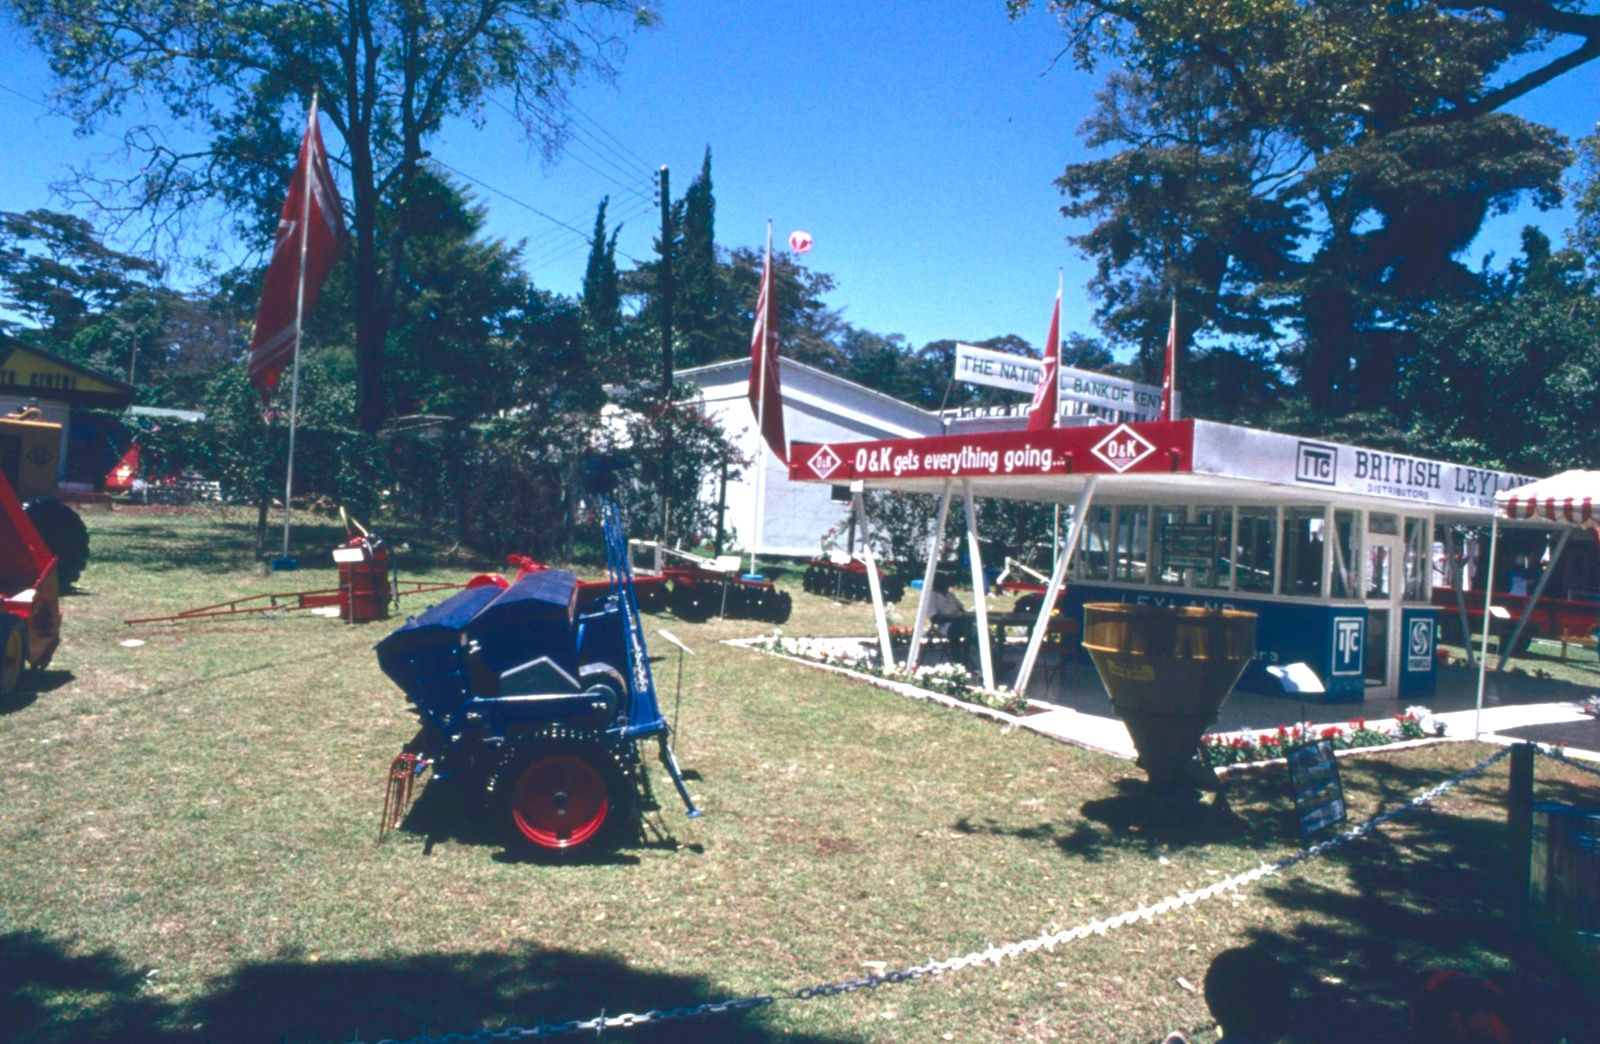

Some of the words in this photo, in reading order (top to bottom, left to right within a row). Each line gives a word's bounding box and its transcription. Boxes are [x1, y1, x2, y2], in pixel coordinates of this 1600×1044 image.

[962, 355, 994, 376] THE
[1000, 363, 1066, 390] NATIOL
[1074, 378, 1109, 398] BANK
[1112, 387, 1130, 402] OF
[1134, 391, 1164, 408] KENY
[893, 449, 919, 476] gets
[924, 446, 998, 474] everything
[1108, 439, 1137, 458] O&K
[1354, 451, 1442, 489] BRITISH
[1454, 467, 1537, 496] LEYLA
[1367, 484, 1429, 500] DISTRIBUTORS
